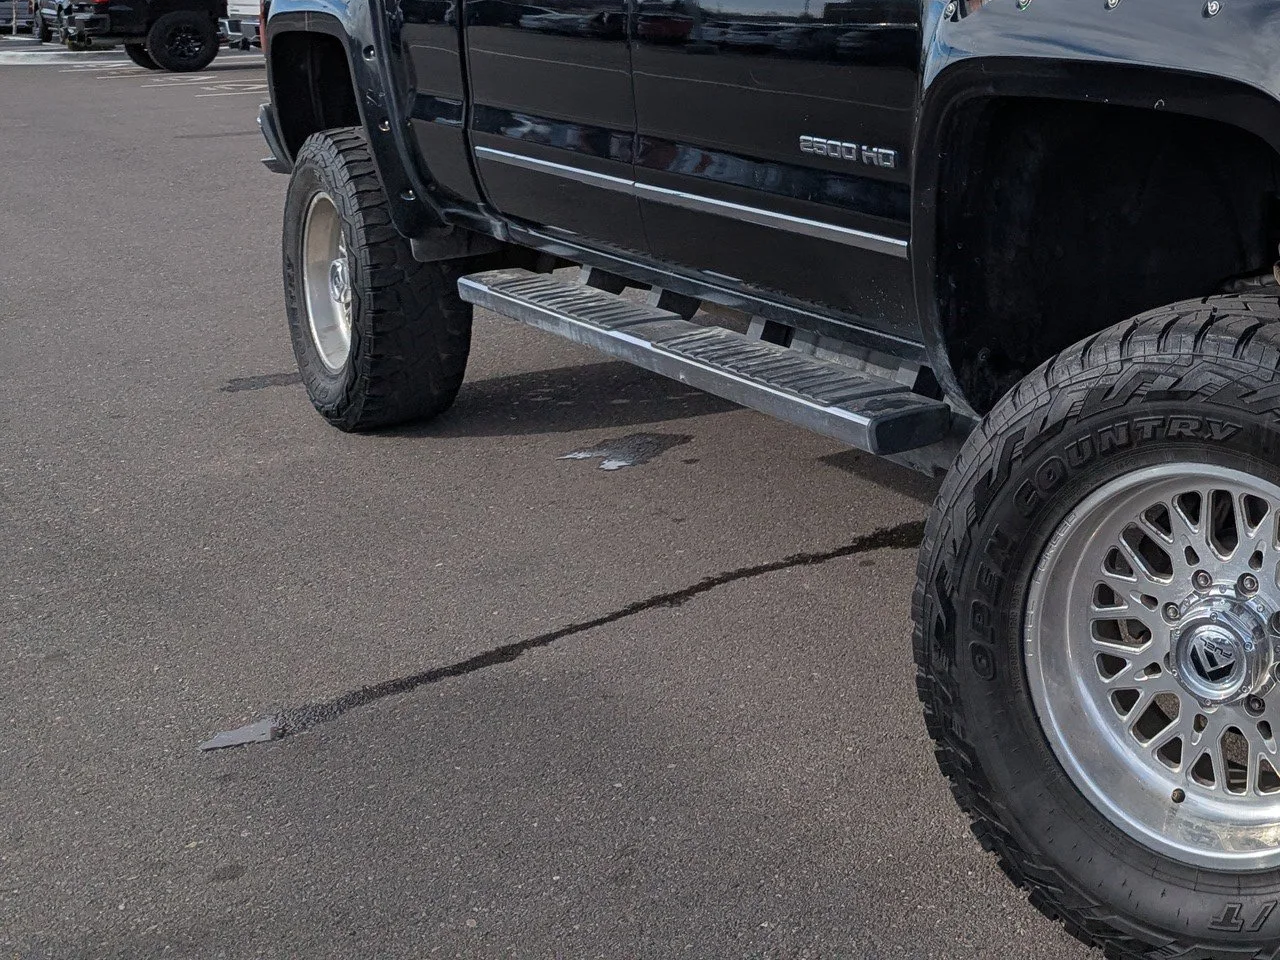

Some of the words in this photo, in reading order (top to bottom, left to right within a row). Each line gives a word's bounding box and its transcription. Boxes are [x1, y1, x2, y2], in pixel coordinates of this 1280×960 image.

[799, 135, 857, 161] 2500
[861, 145, 897, 168] HD
[1013, 415, 1243, 516] COUNTRY
[1200, 637, 1233, 659] FUEL
